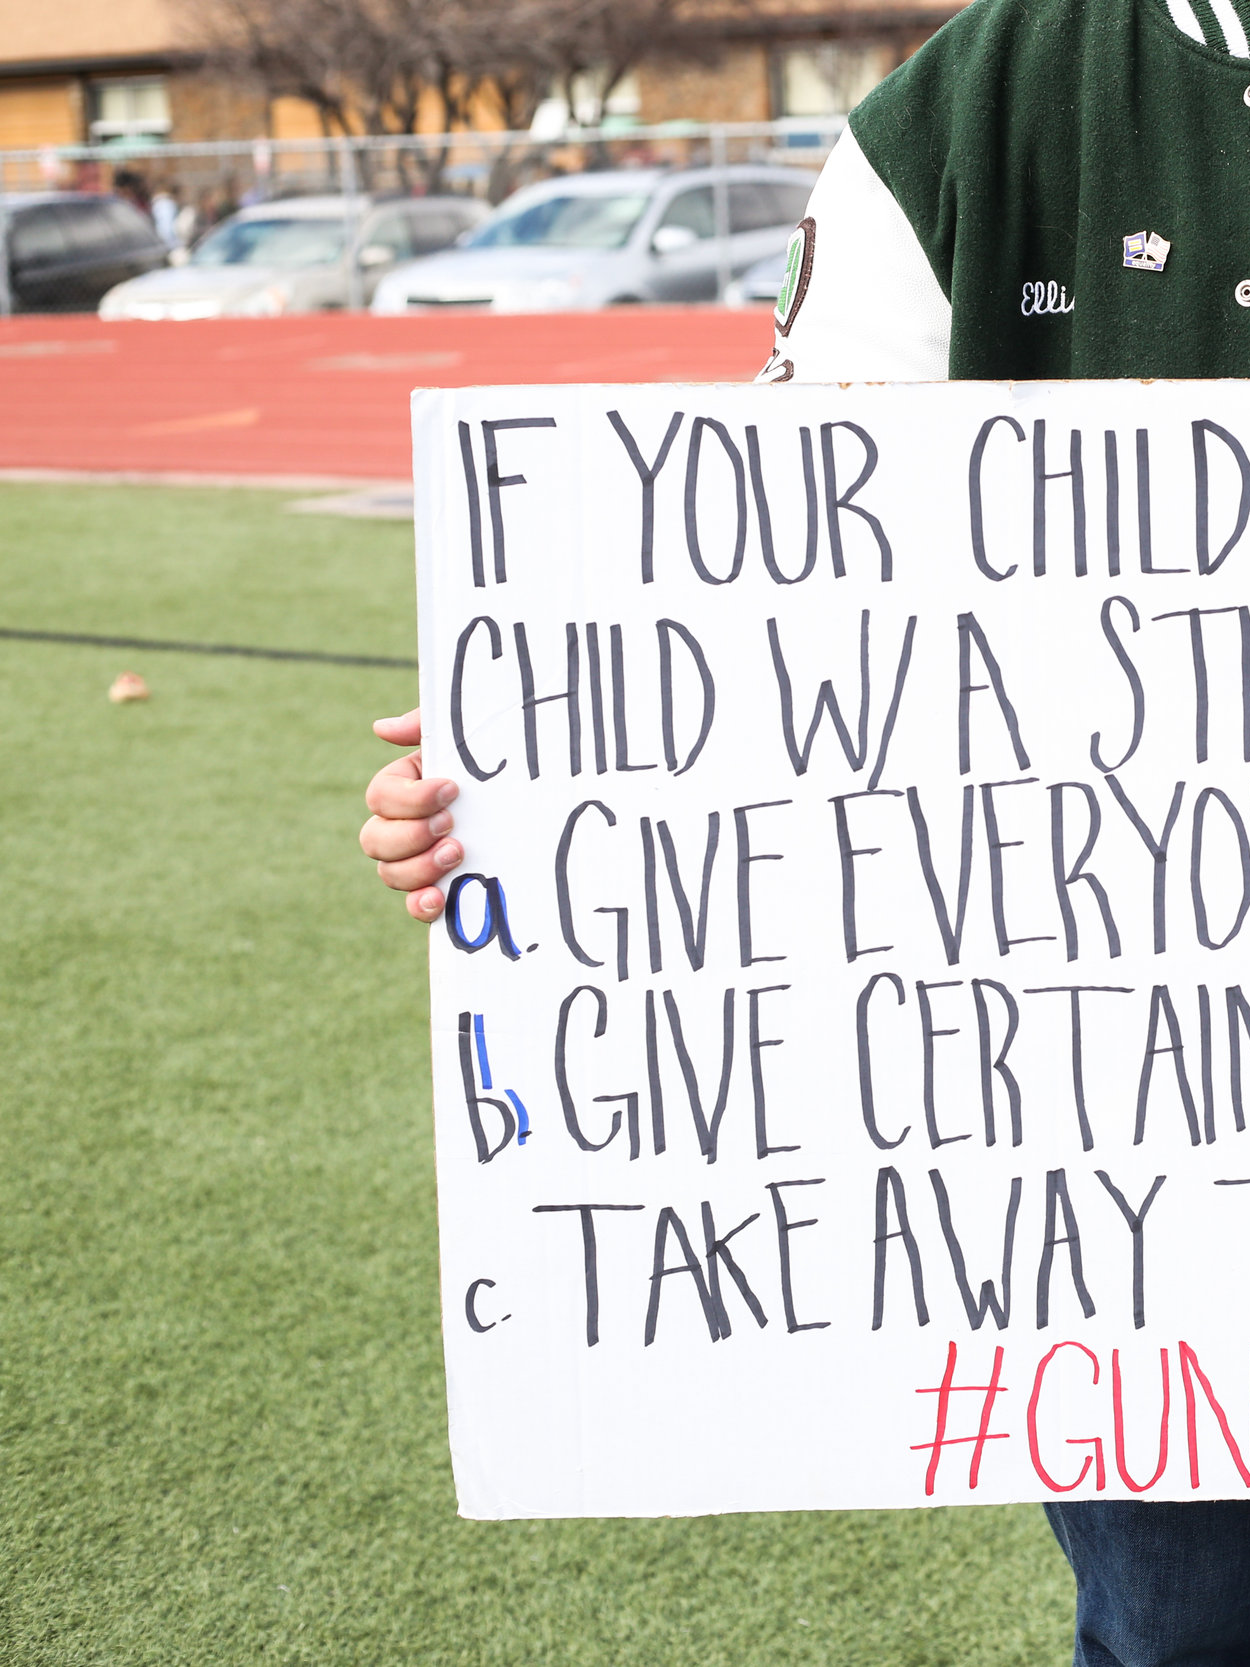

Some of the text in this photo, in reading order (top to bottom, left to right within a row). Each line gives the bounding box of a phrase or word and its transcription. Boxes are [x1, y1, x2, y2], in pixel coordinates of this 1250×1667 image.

[457, 417, 557, 588] IF
[606, 410, 893, 586] YOUR
[450, 615, 716, 783] CHILD
[956, 611, 1031, 776] A
[554, 799, 793, 983] GIVE
[554, 984, 802, 1165] GIVE
[531, 1178, 832, 1348] TAKE
[871, 1165, 1167, 1332] AWAY
